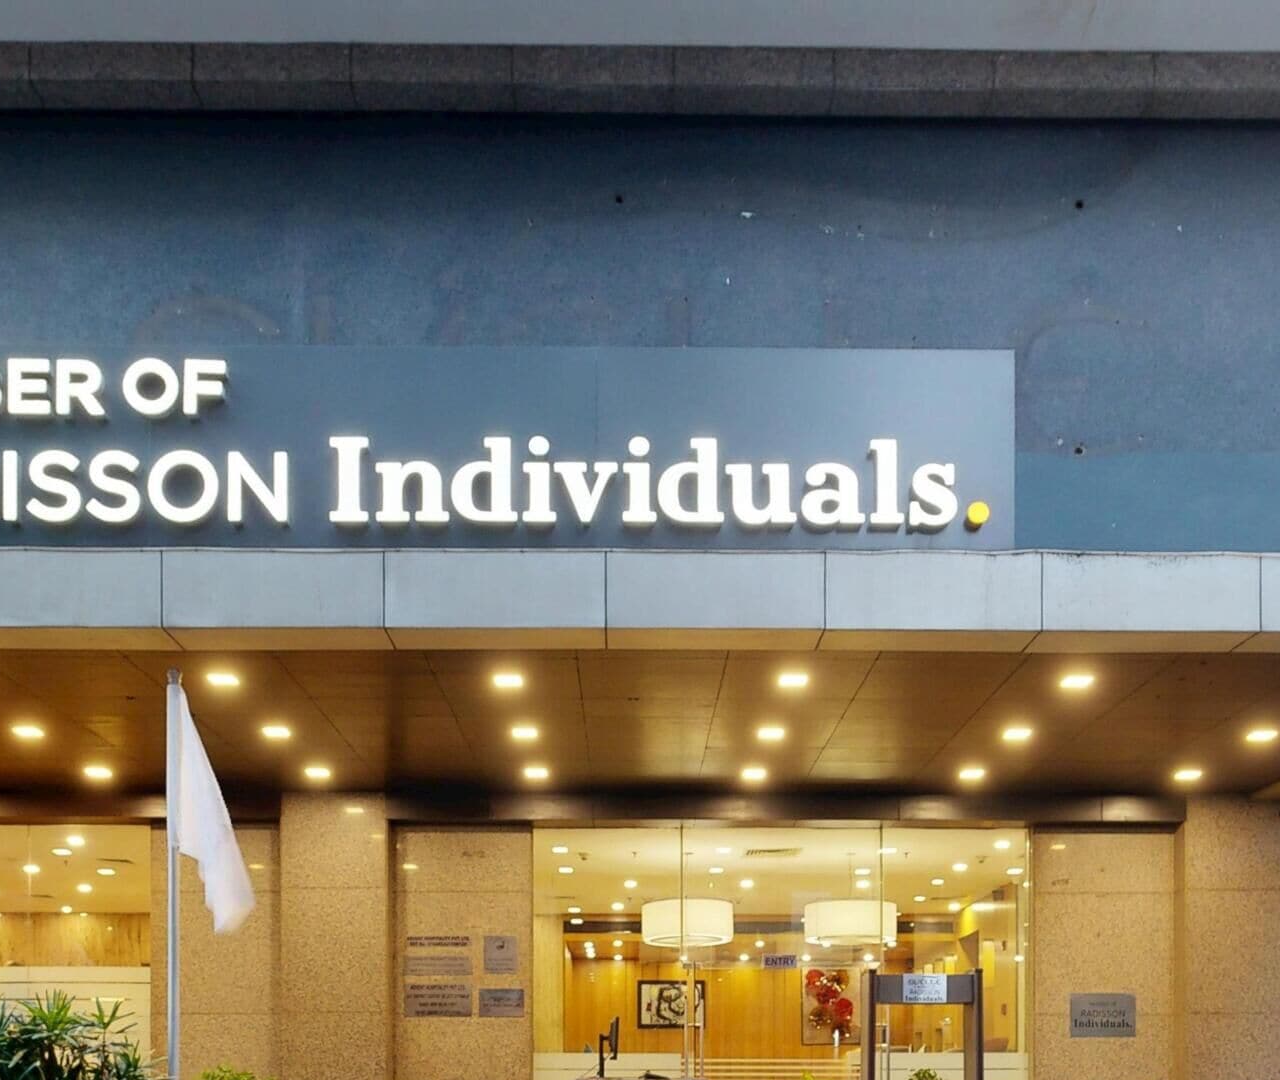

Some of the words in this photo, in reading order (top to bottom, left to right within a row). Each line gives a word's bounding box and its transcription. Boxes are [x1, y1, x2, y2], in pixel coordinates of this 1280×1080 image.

[120, 356, 229, 418] OF
[328, 434, 991, 531] Individuals.
[765, 955, 797, 966] ENTRY
